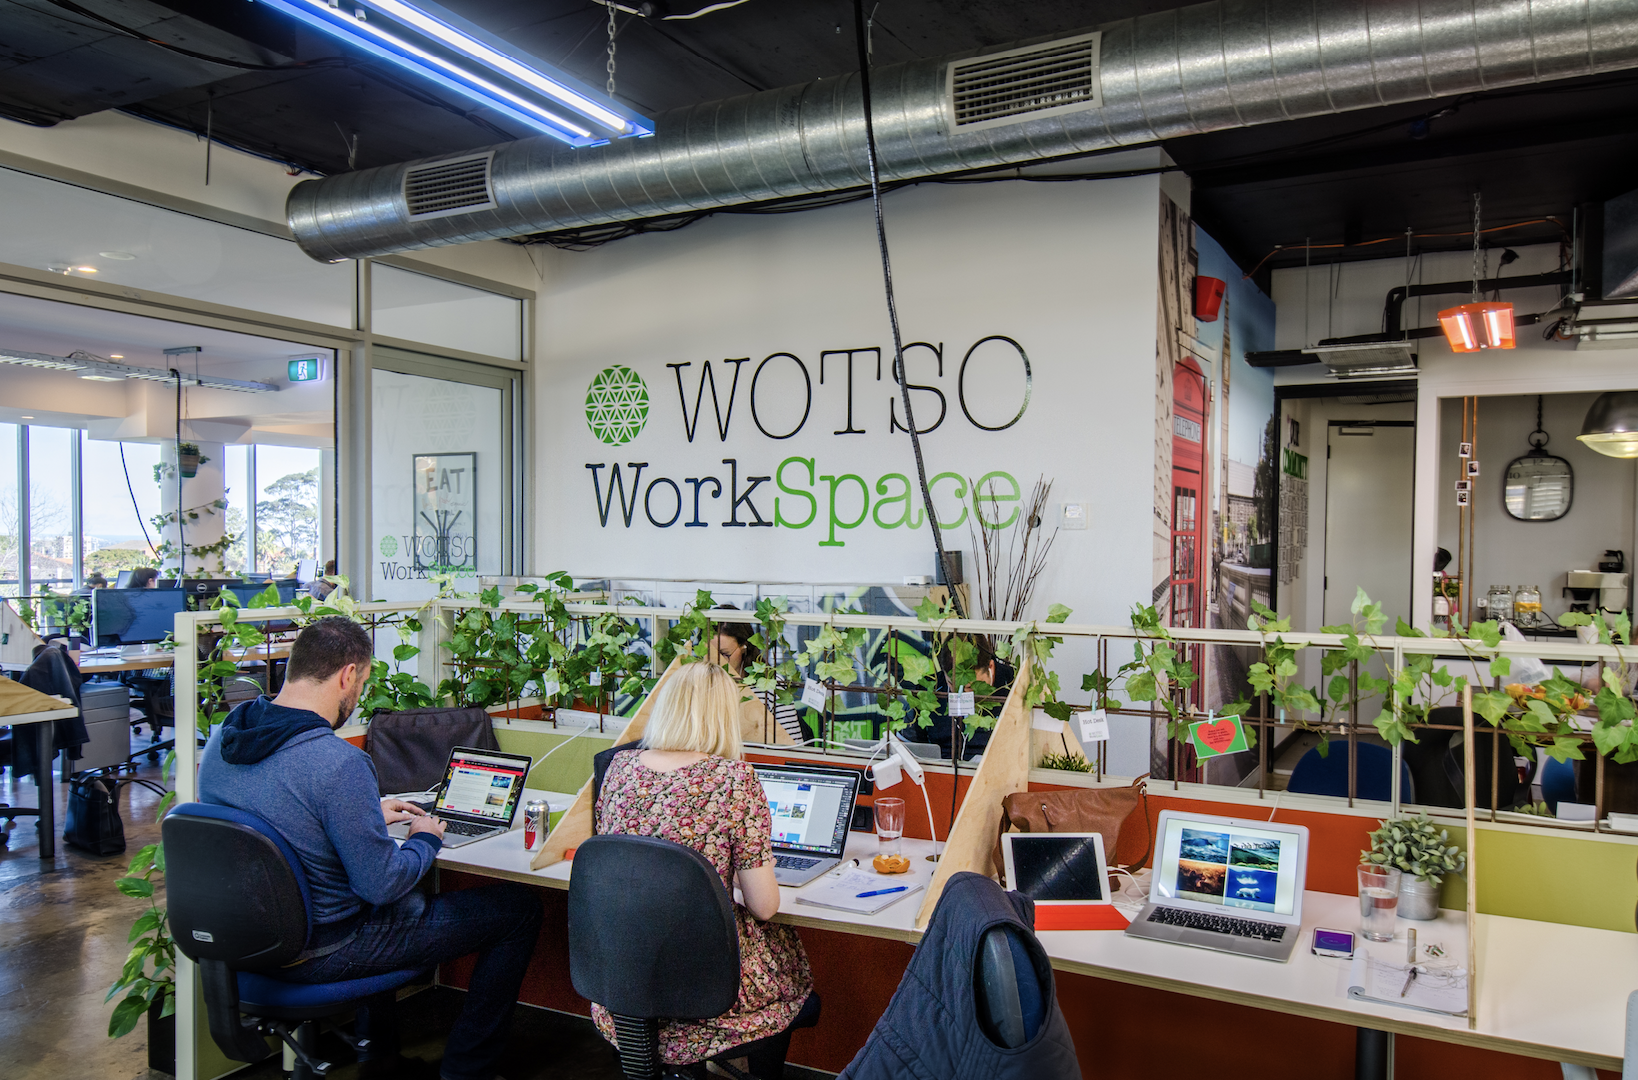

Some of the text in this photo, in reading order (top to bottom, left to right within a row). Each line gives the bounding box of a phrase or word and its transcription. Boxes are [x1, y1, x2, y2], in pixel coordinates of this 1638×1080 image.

[666, 335, 1032, 443] WOTSO
[1173, 415, 1200, 442] TELEPHONE
[425, 467, 465, 494] EAT
[585, 456, 1021, 547] WorkSpace
[402, 536, 476, 557] WOTSO
